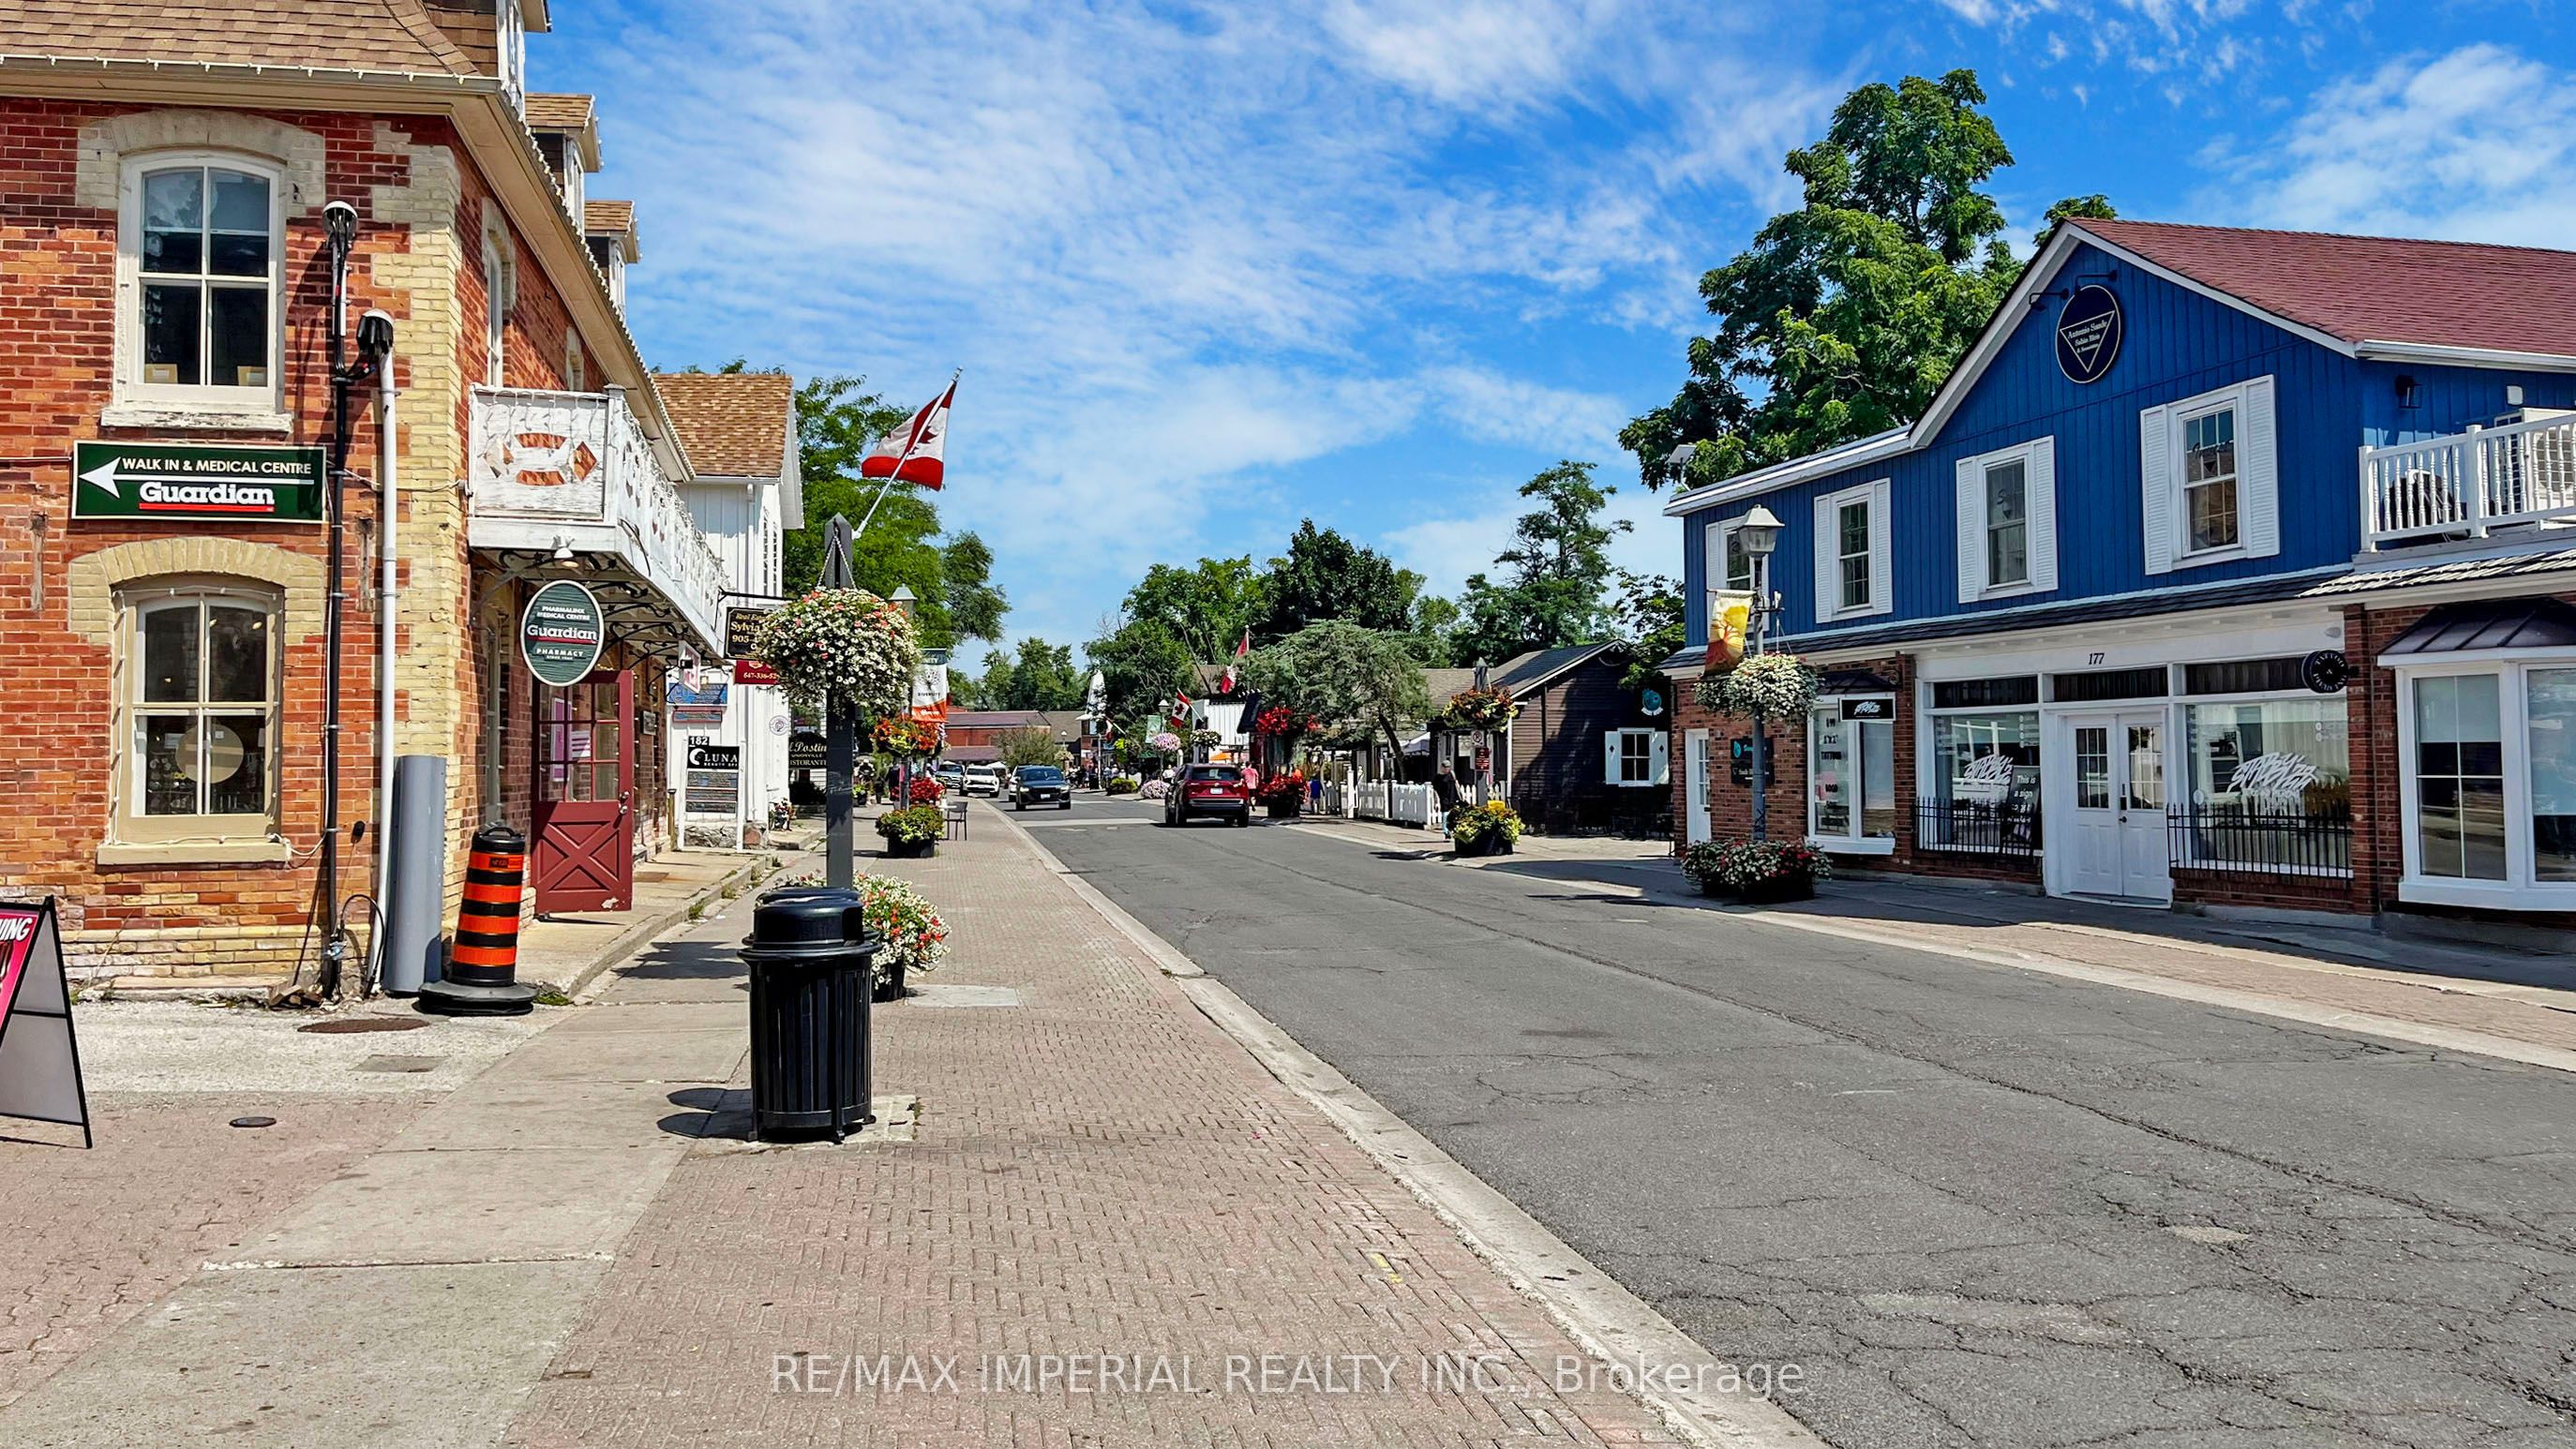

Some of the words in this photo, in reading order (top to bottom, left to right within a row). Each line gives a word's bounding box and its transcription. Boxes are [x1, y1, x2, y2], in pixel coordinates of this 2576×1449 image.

[123, 457, 162, 471] WALK
[165, 458, 181, 471] IN
[183, 459, 191, 471] &
[195, 460, 260, 473] MEDICAL
[261, 462, 312, 474] CENTRE
[139, 481, 276, 504] Guardian
[536, 611, 565, 620] MEDICAL
[565, 613, 591, 621] CENTRE
[526, 624, 598, 640] Guardian
[731, 621, 760, 632] Sylvia
[536, 649, 584, 657] PHARMACY
[2089, 652, 2105, 665] 177
[2315, 652, 2345, 667] TATTOO
[690, 737, 709, 745] 182
[794, 741, 827, 753] Postin
[704, 754, 738, 762] LUNA
[2016, 775, 2029, 784] This
[2029, 776, 2037, 784] is
[2019, 788, 2033, 799] sign
